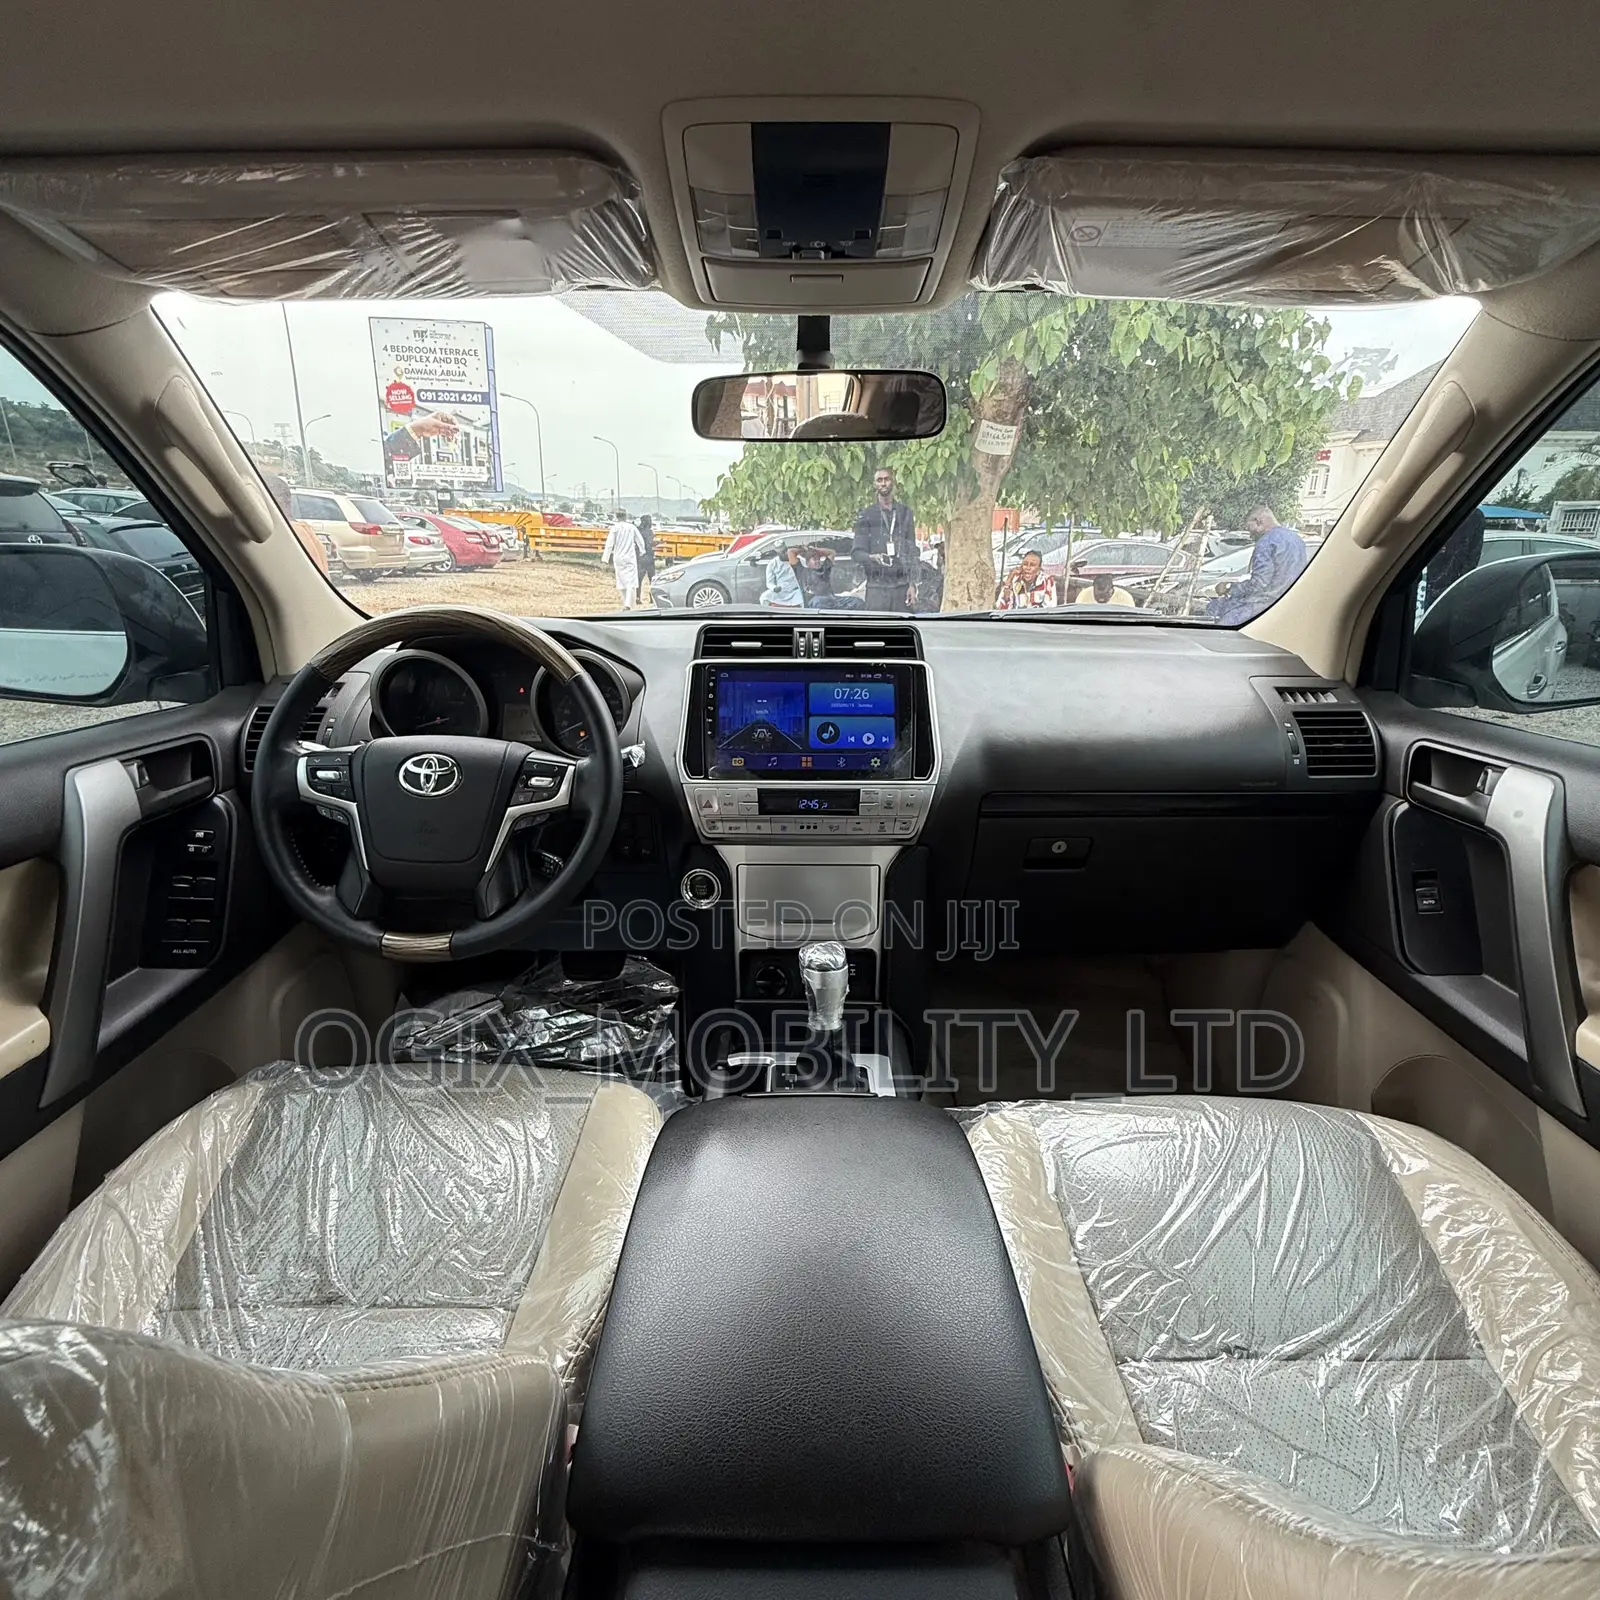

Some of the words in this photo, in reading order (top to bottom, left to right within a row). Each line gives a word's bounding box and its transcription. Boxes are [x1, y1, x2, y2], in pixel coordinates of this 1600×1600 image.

[390, 345, 437, 355] BEDROOM
[438, 348, 479, 357] TERRACE
[395, 354, 431, 364] DUPLEX
[432, 356, 452, 364] AND
[454, 357, 468, 367] BQ
[404, 367, 437, 376] DAWAKI
[420, 391, 436, 400] 091
[438, 392, 459, 401] 2021
[461, 393, 482, 402] 4241
[834, 688, 870, 700] 07:26
